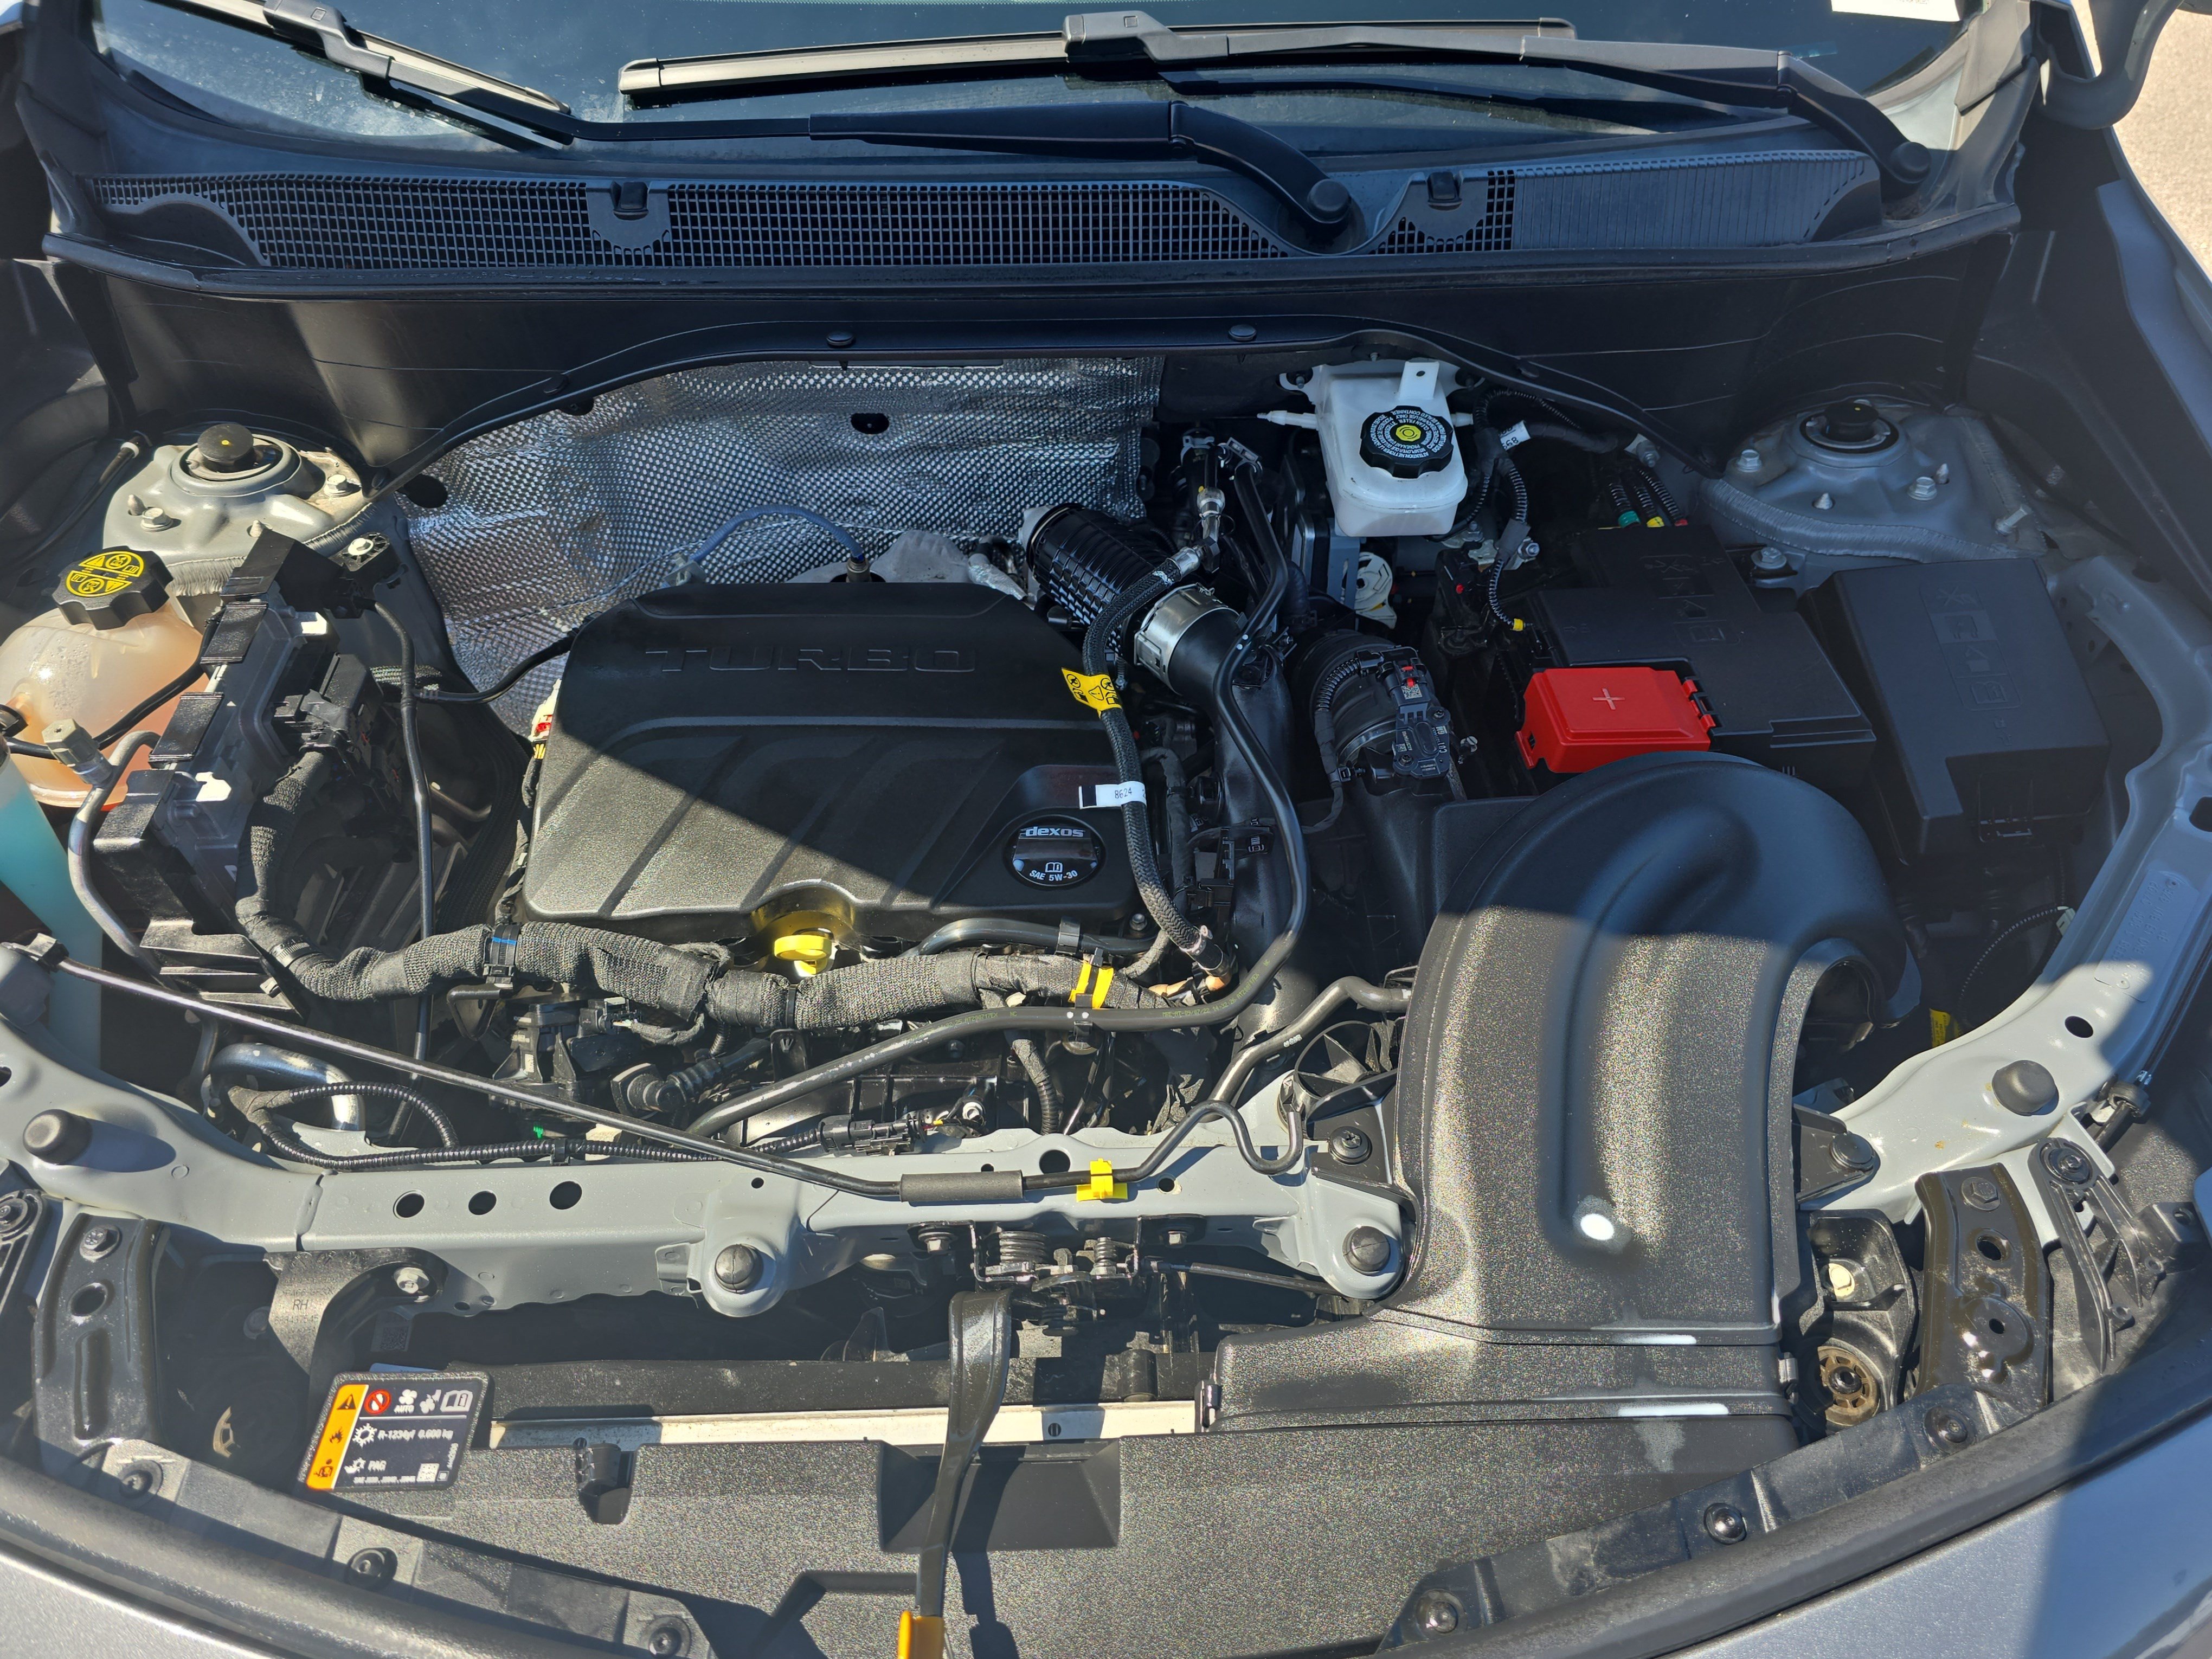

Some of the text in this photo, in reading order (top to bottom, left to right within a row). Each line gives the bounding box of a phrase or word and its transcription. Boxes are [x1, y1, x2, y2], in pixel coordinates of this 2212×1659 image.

[645, 645, 975, 673] TURBO
[1436, 726, 1445, 735] GM
[1115, 787, 1132, 799] 8624
[1026, 827, 1083, 837] dexos
[1030, 870, 1078, 882] SAE 5W-30
[293, 1300, 308, 1311] RH
[394, 1405, 414, 1414] AUTO
[368, 1460, 387, 1472] PAG
